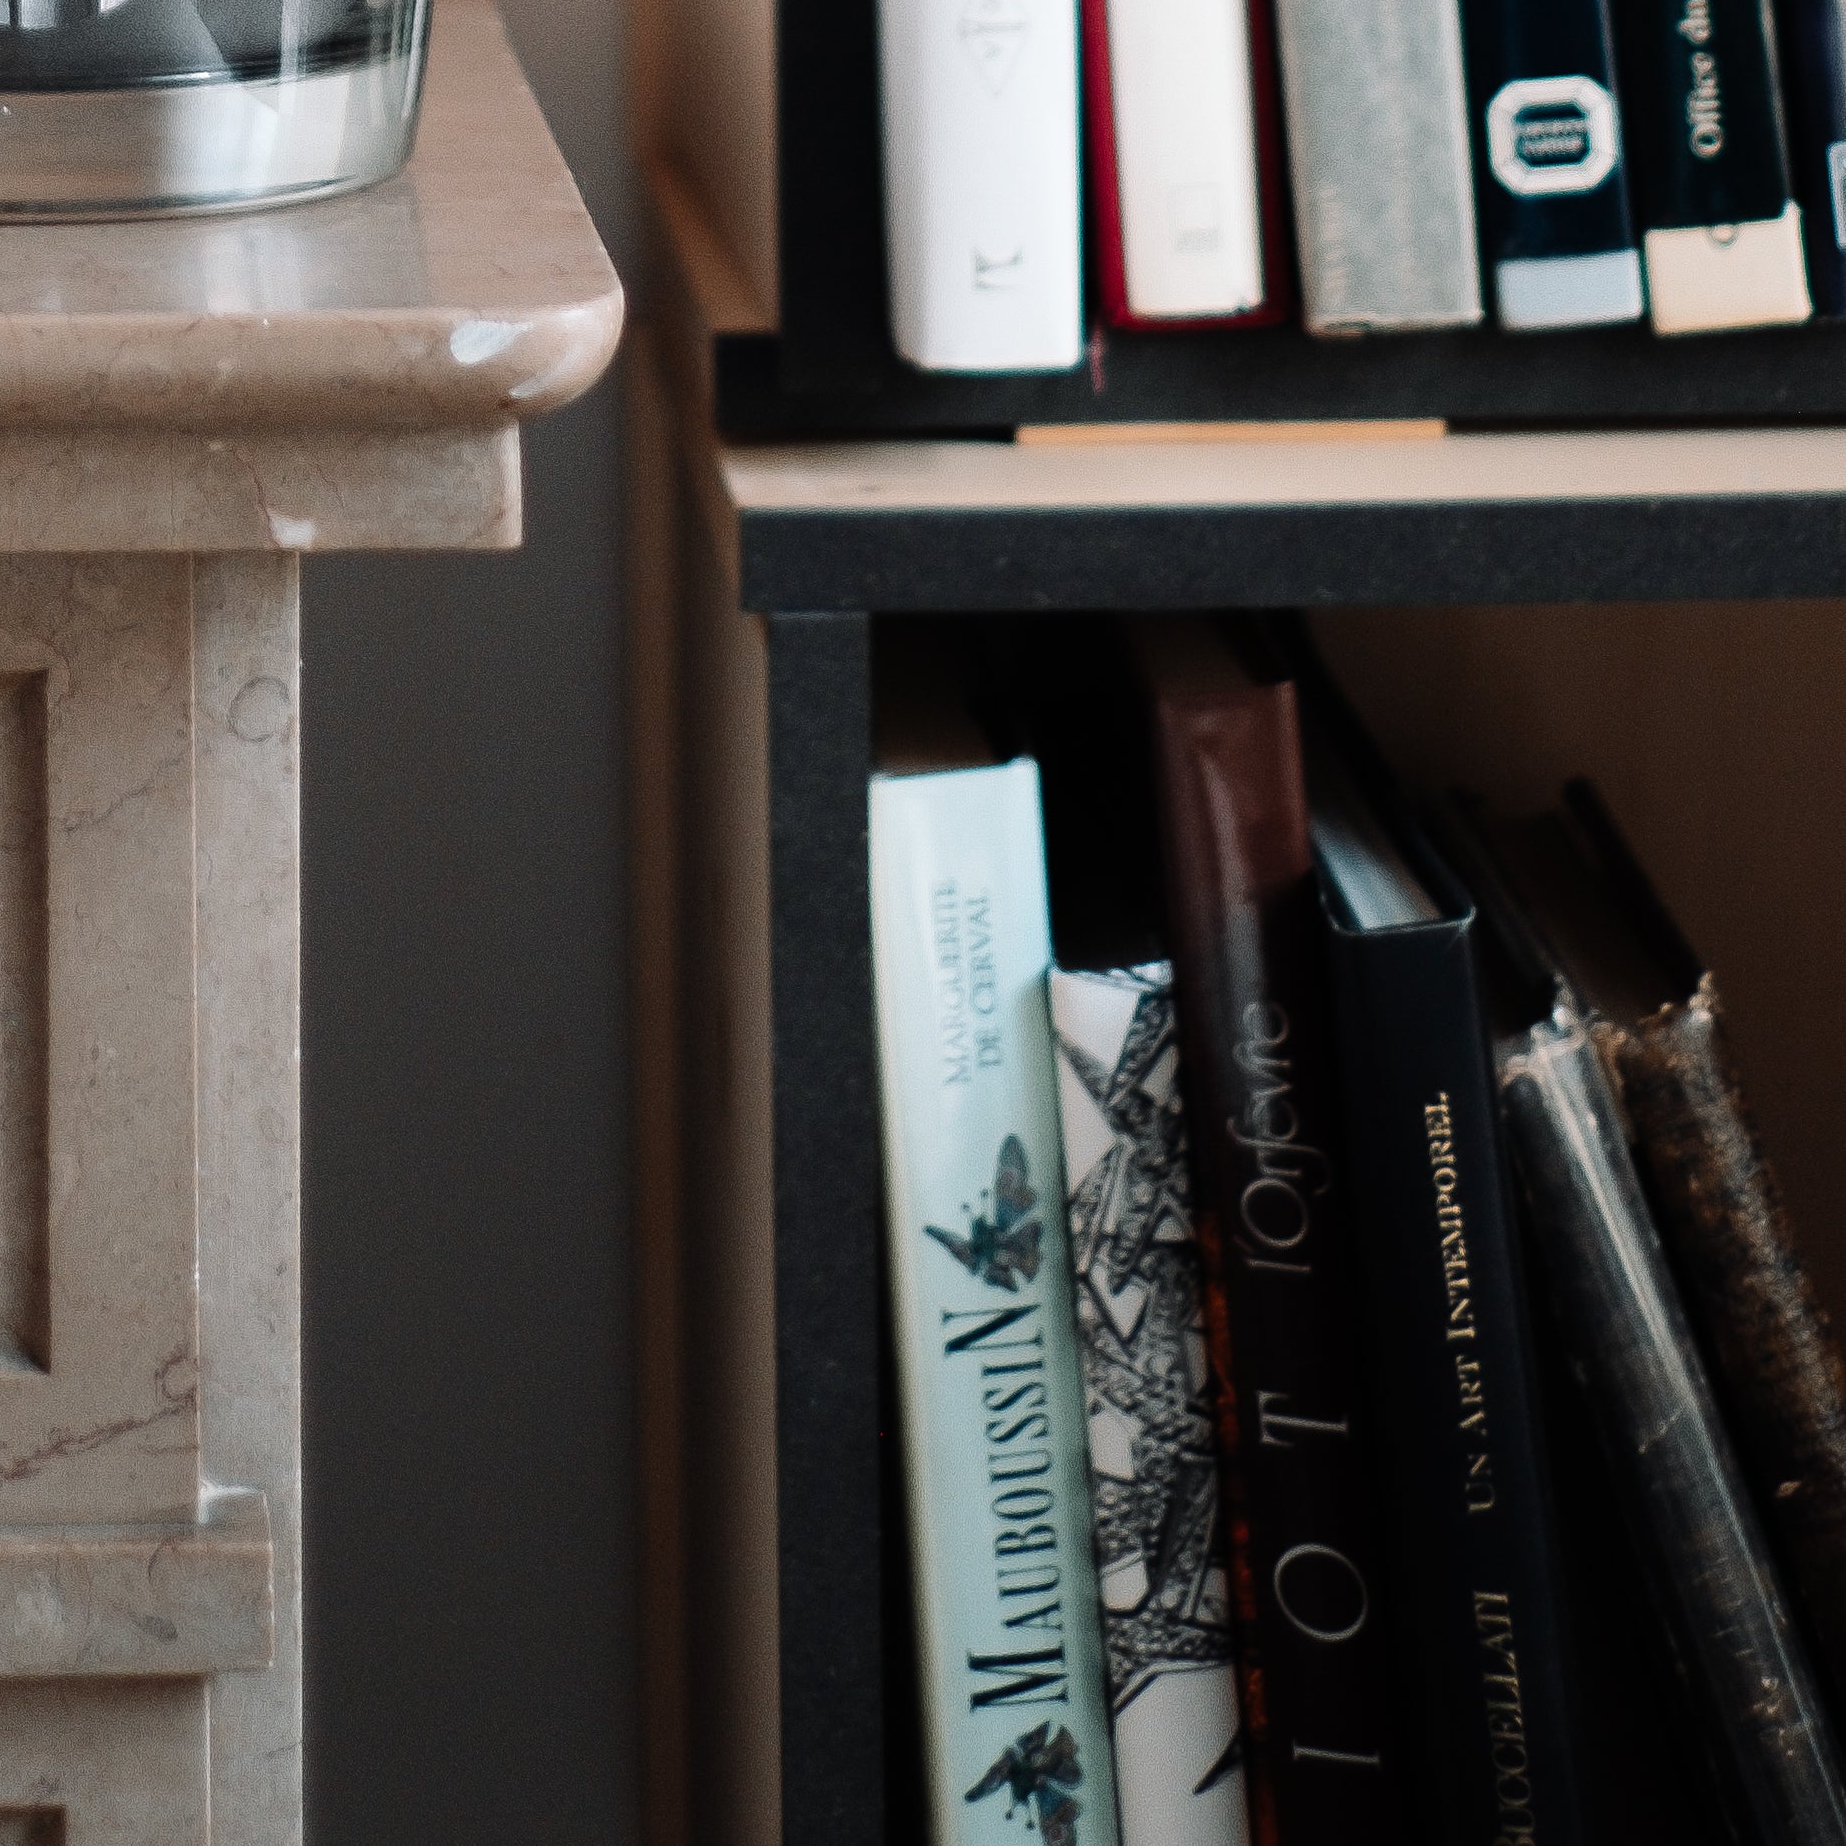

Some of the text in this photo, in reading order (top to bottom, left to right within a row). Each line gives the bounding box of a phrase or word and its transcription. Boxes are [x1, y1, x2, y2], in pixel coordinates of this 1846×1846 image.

[1686, 51, 1722, 161] Office
[977, 1030, 1005, 1070] DE
[1456, 1355, 1489, 1437] ART
[941, 1302, 1069, 1713] MAUBOUSSIN
